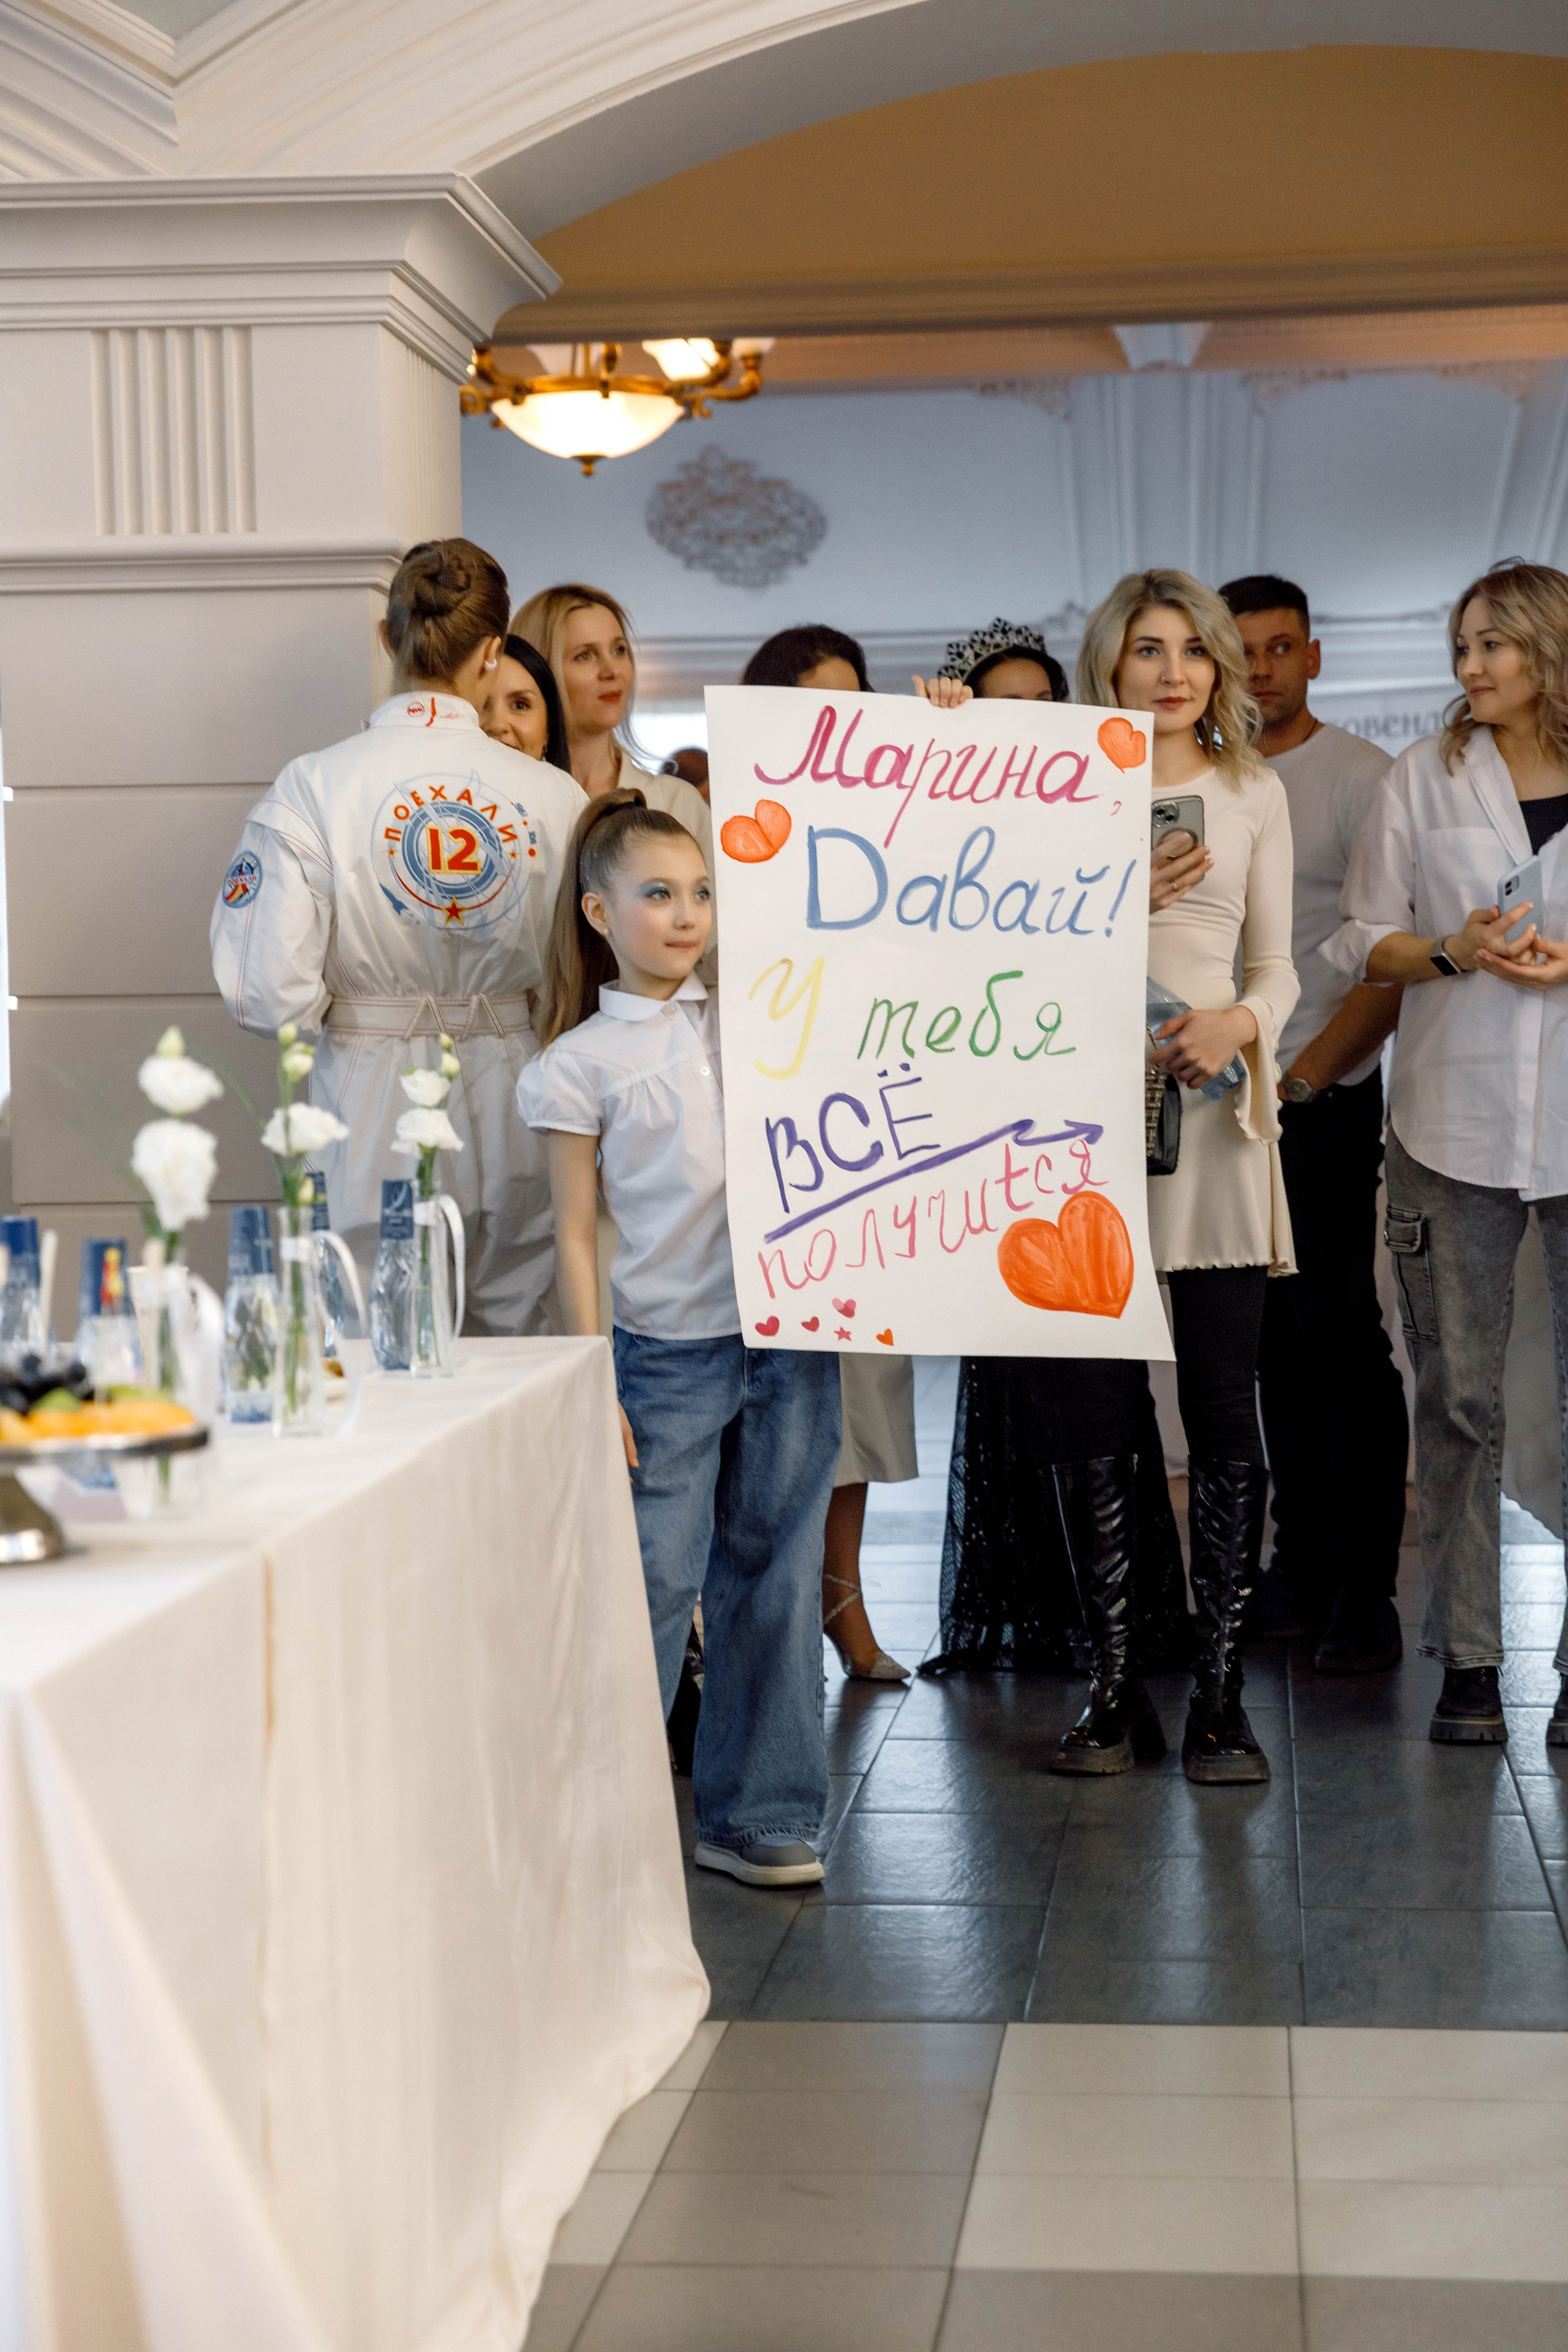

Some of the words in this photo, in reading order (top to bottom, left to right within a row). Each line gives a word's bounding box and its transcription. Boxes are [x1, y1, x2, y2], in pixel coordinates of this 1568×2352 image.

[383, 785, 519, 843] ПОЕХАЛИ
[427, 826, 481, 874] 12
[856, 970, 1077, 1061] тебя
